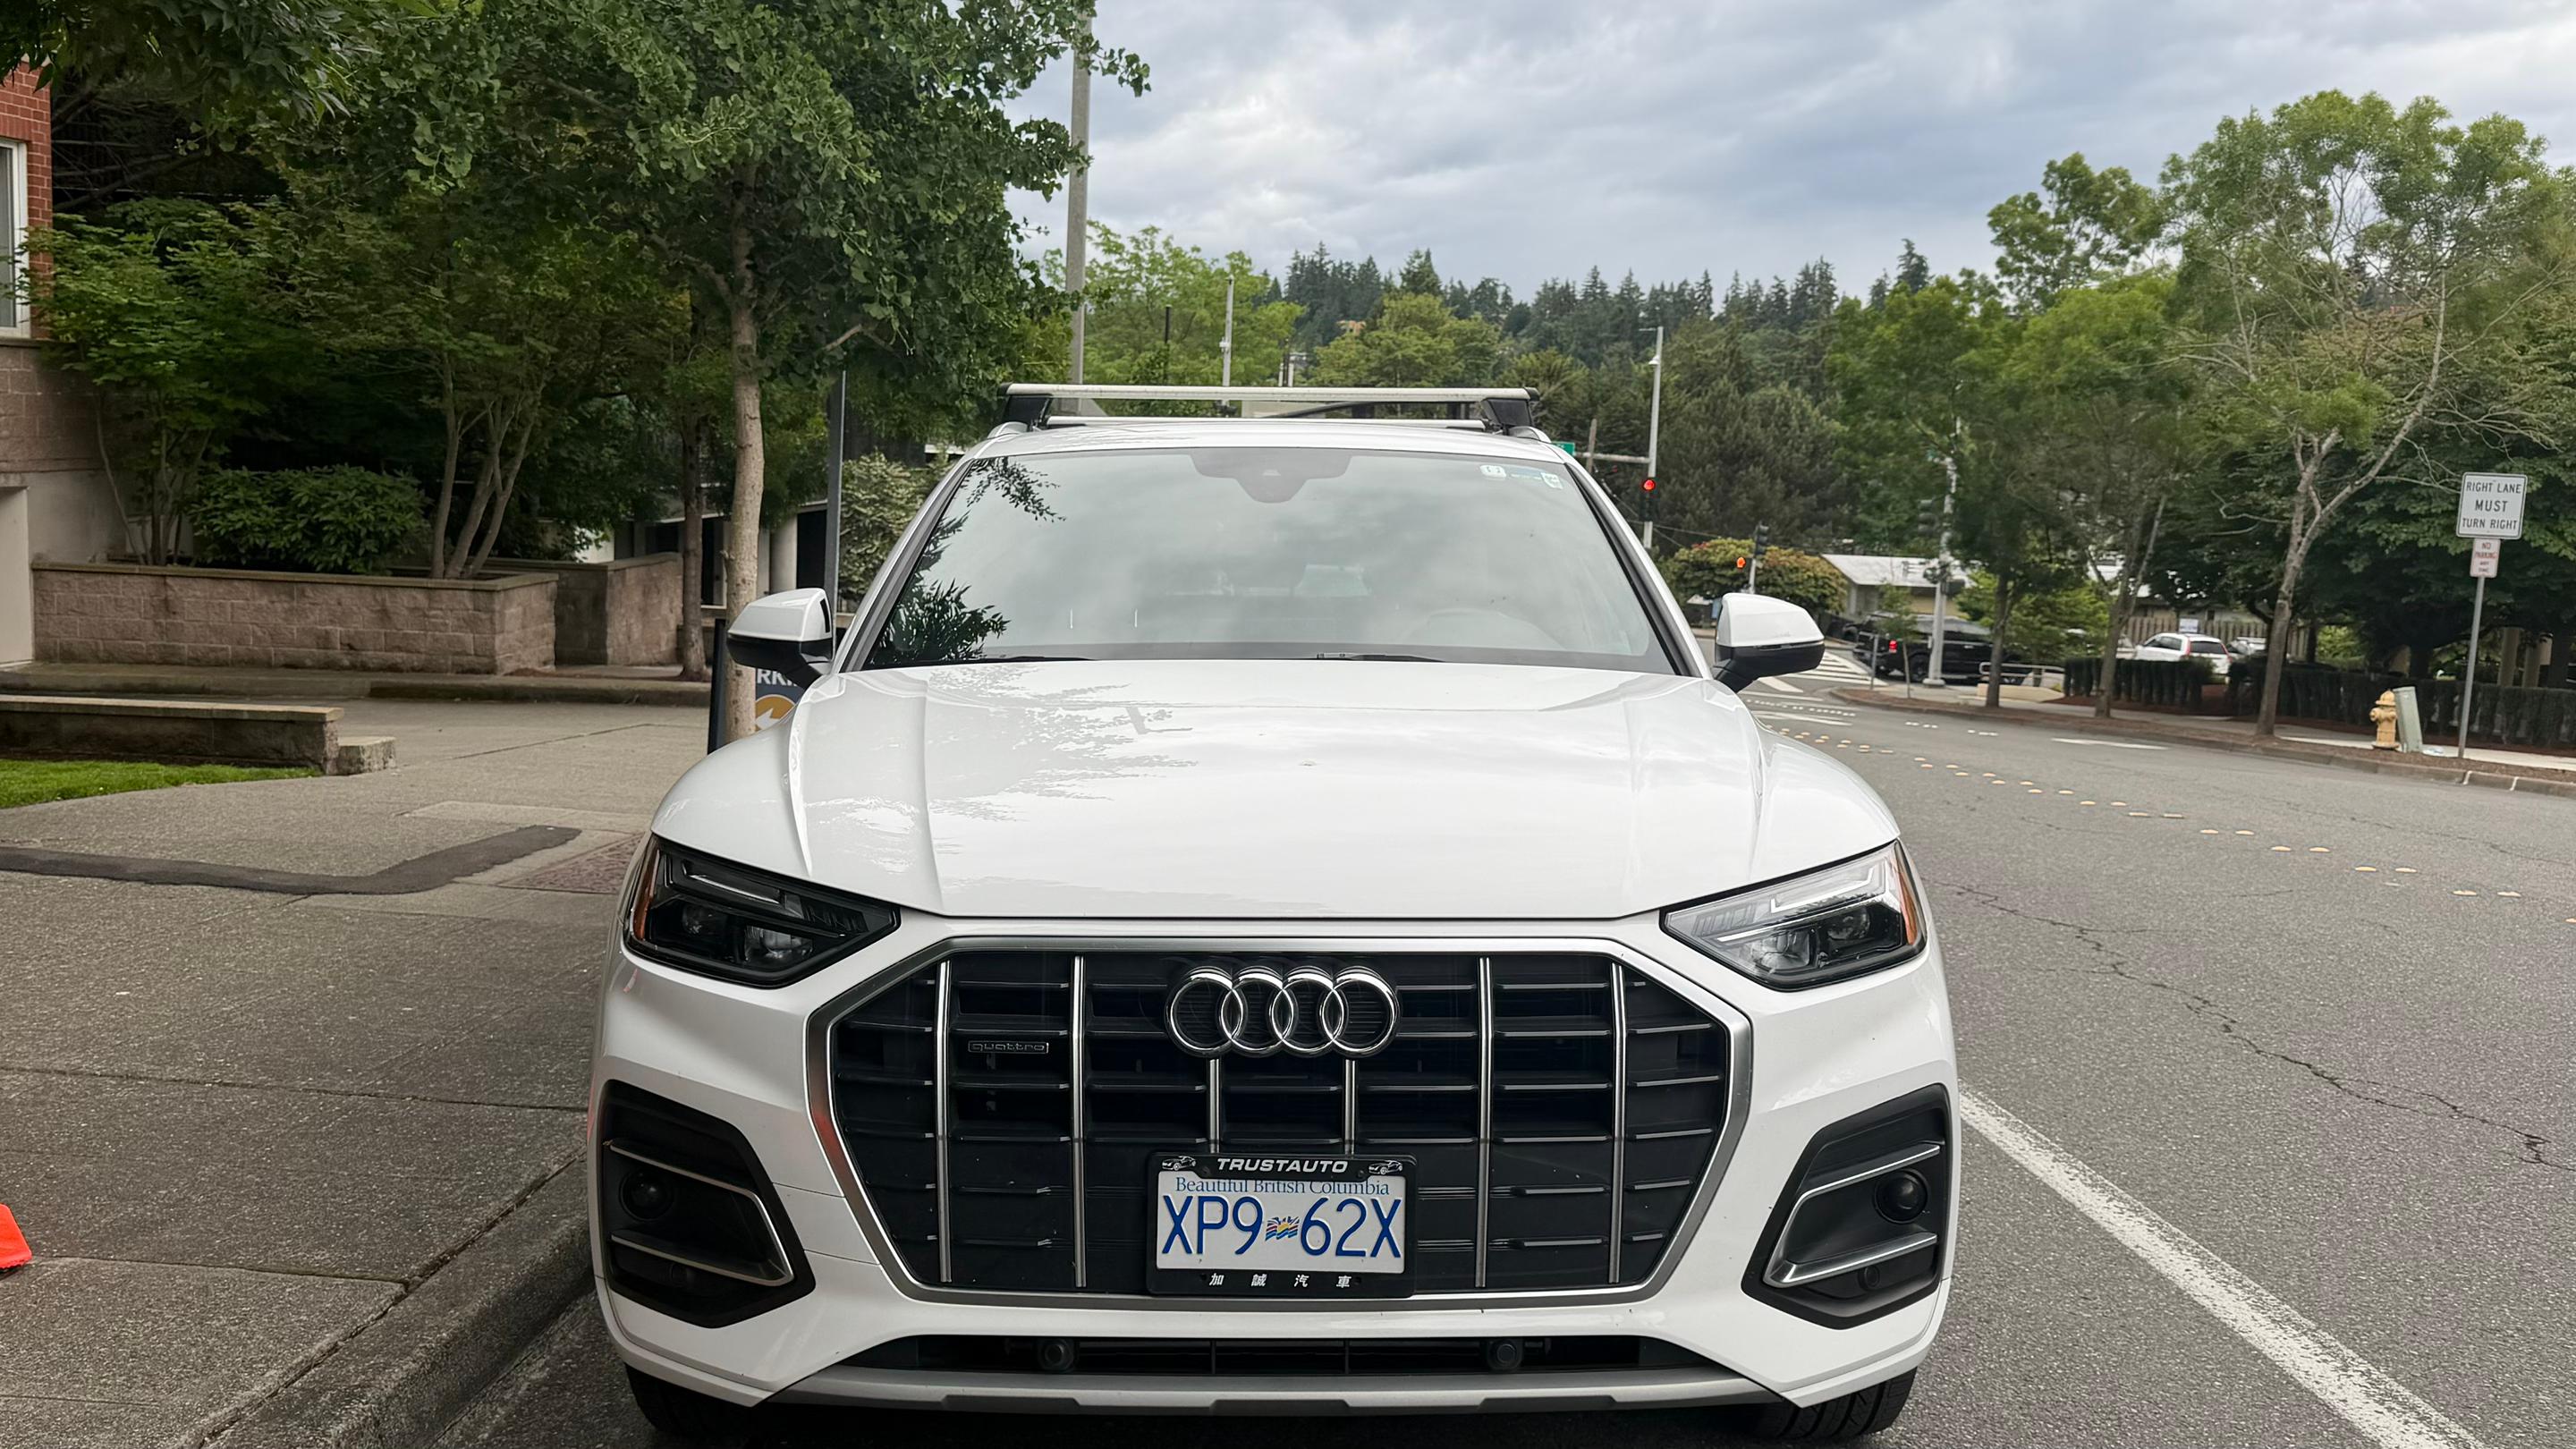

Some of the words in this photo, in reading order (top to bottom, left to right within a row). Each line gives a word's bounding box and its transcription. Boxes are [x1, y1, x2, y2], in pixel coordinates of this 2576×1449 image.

[2466, 481, 2493, 493] RIGHT
[2496, 482, 2521, 494] LANE
[2474, 499, 2508, 513] MUST
[2462, 517, 2486, 529] TURN
[2489, 519, 2517, 530] RIGHT
[971, 1042, 1045, 1052] quattro
[1217, 1157, 1348, 1174] TRUSTAUTO
[1175, 1176, 1248, 1192] Beautiful
[1253, 1180, 1305, 1194] British
[1309, 1180, 1390, 1195] Columbia
[1162, 1195, 1263, 1255] XP9
[1300, 1197, 1402, 1258] 62X
